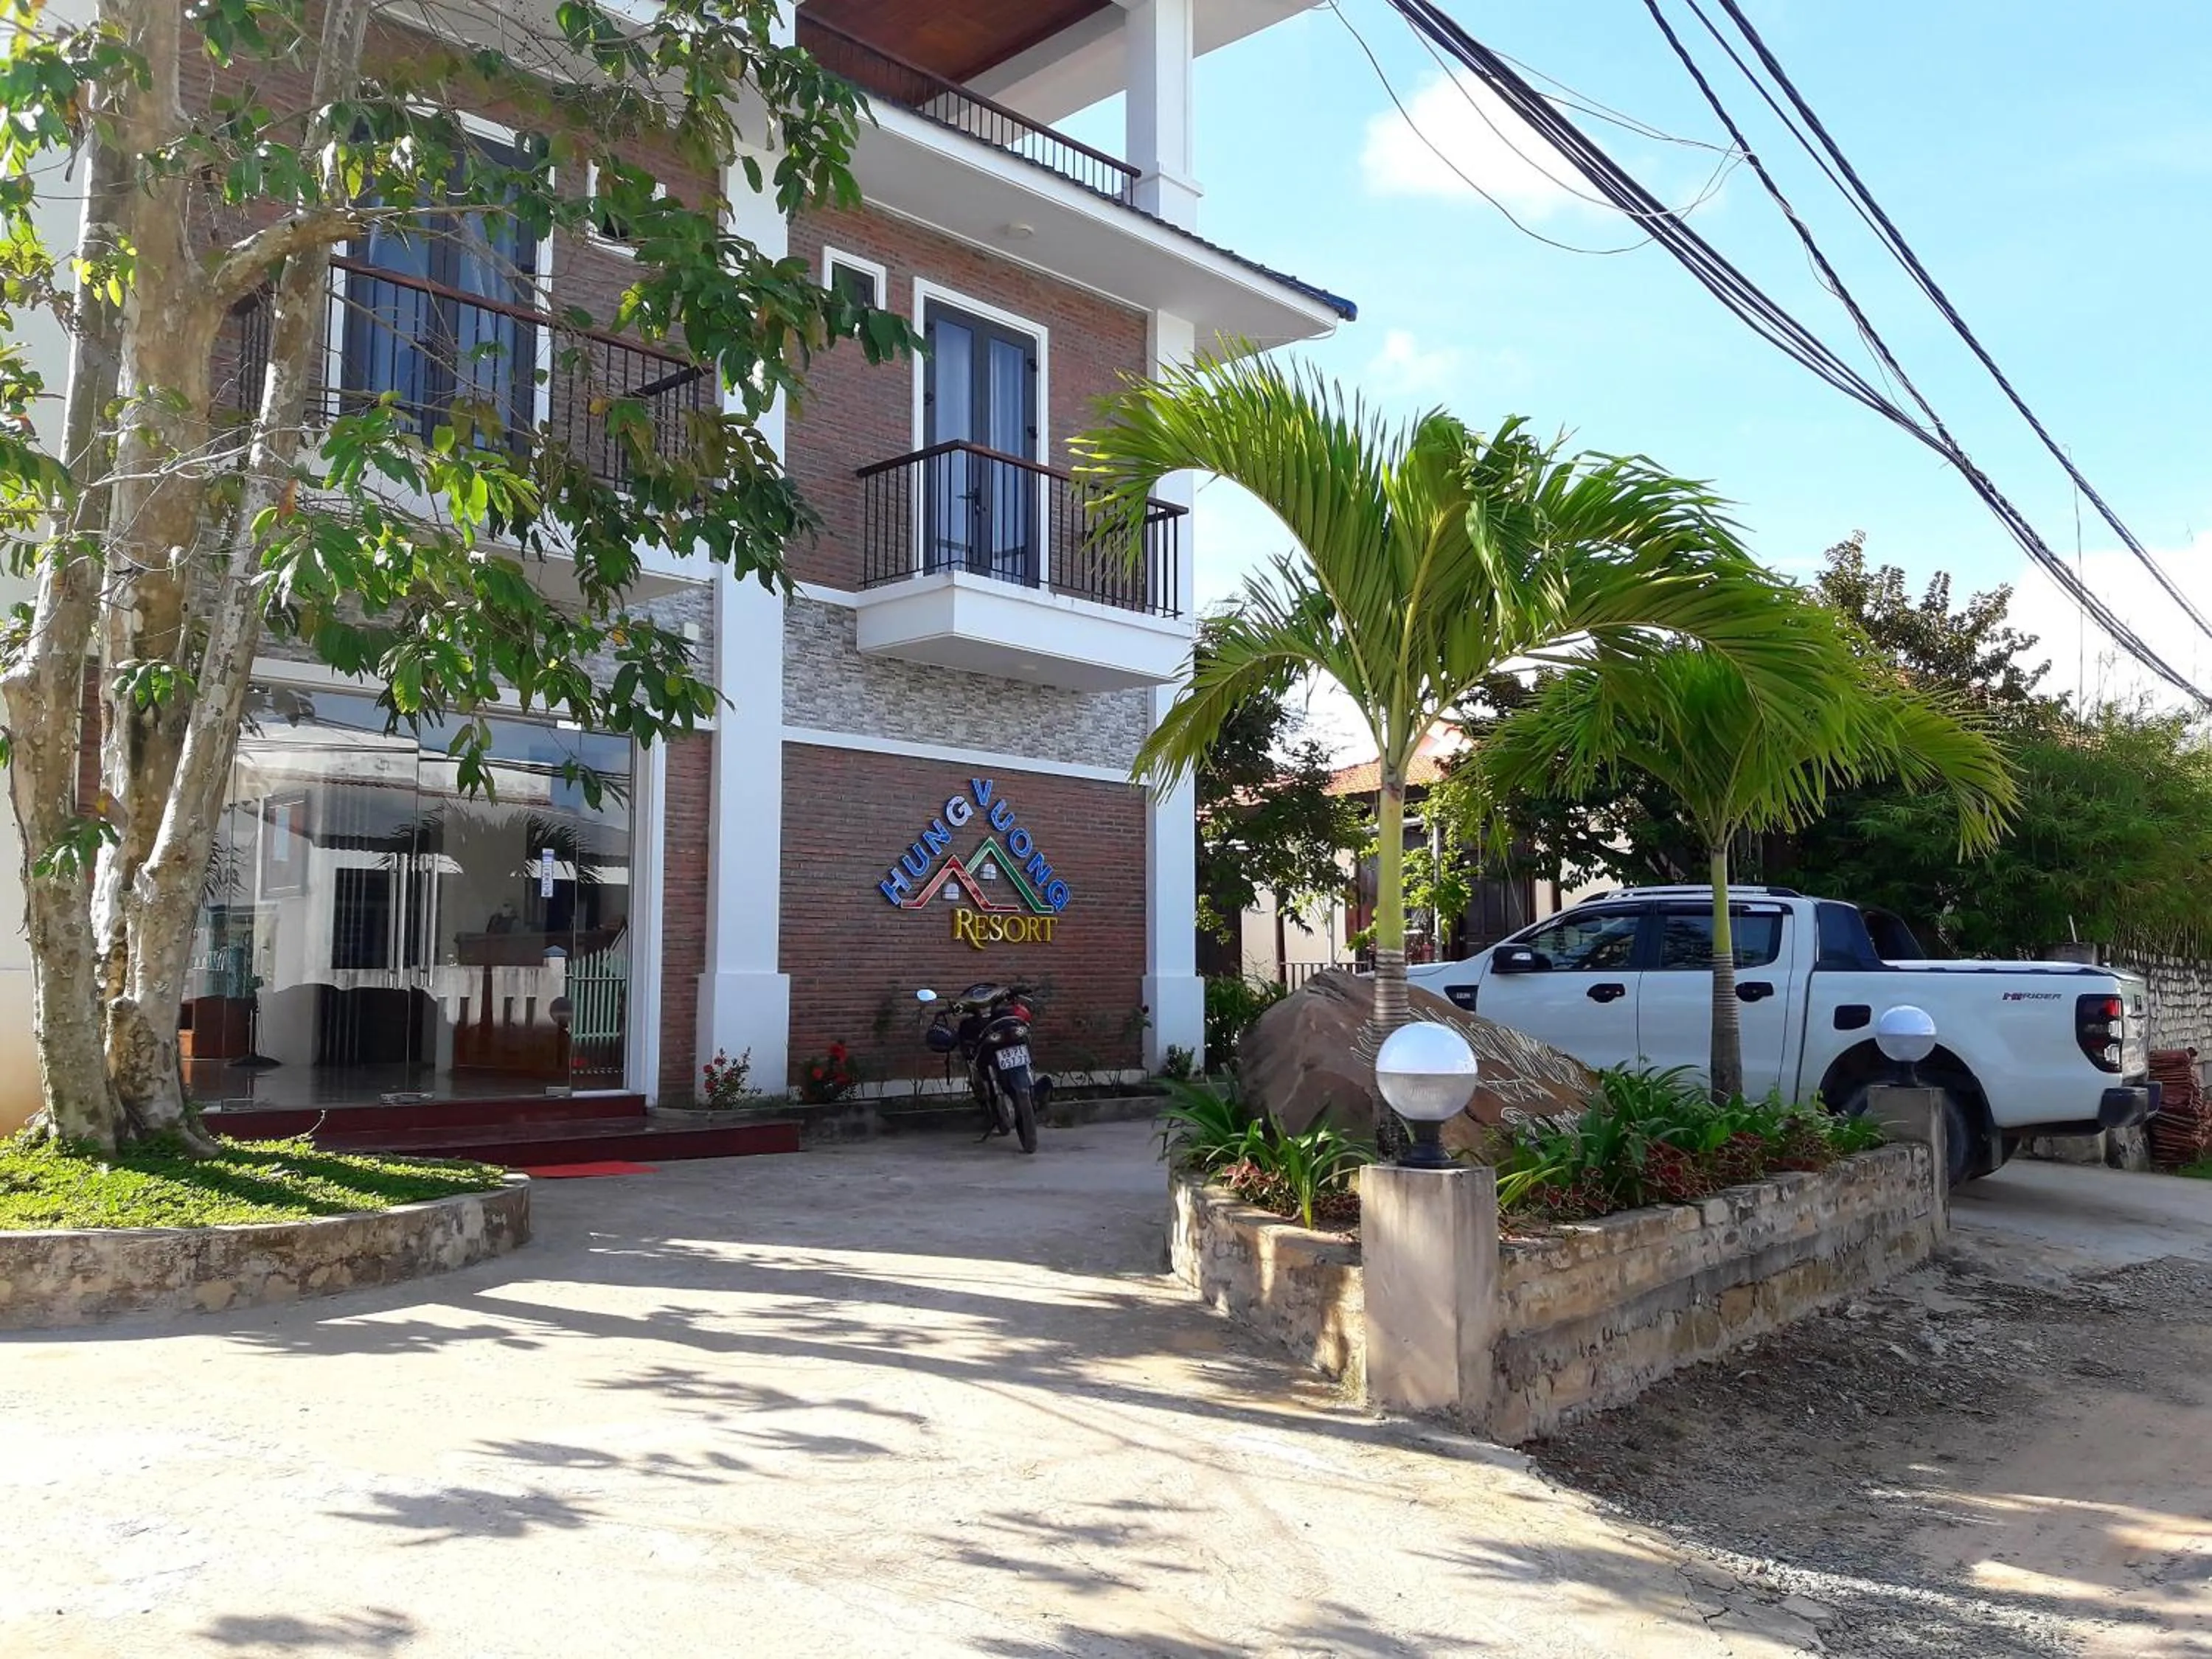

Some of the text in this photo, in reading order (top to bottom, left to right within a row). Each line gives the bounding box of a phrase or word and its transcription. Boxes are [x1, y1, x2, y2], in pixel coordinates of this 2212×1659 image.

[880, 778, 1071, 911] HUNG VUONG
[952, 907, 1057, 950] RESORT
